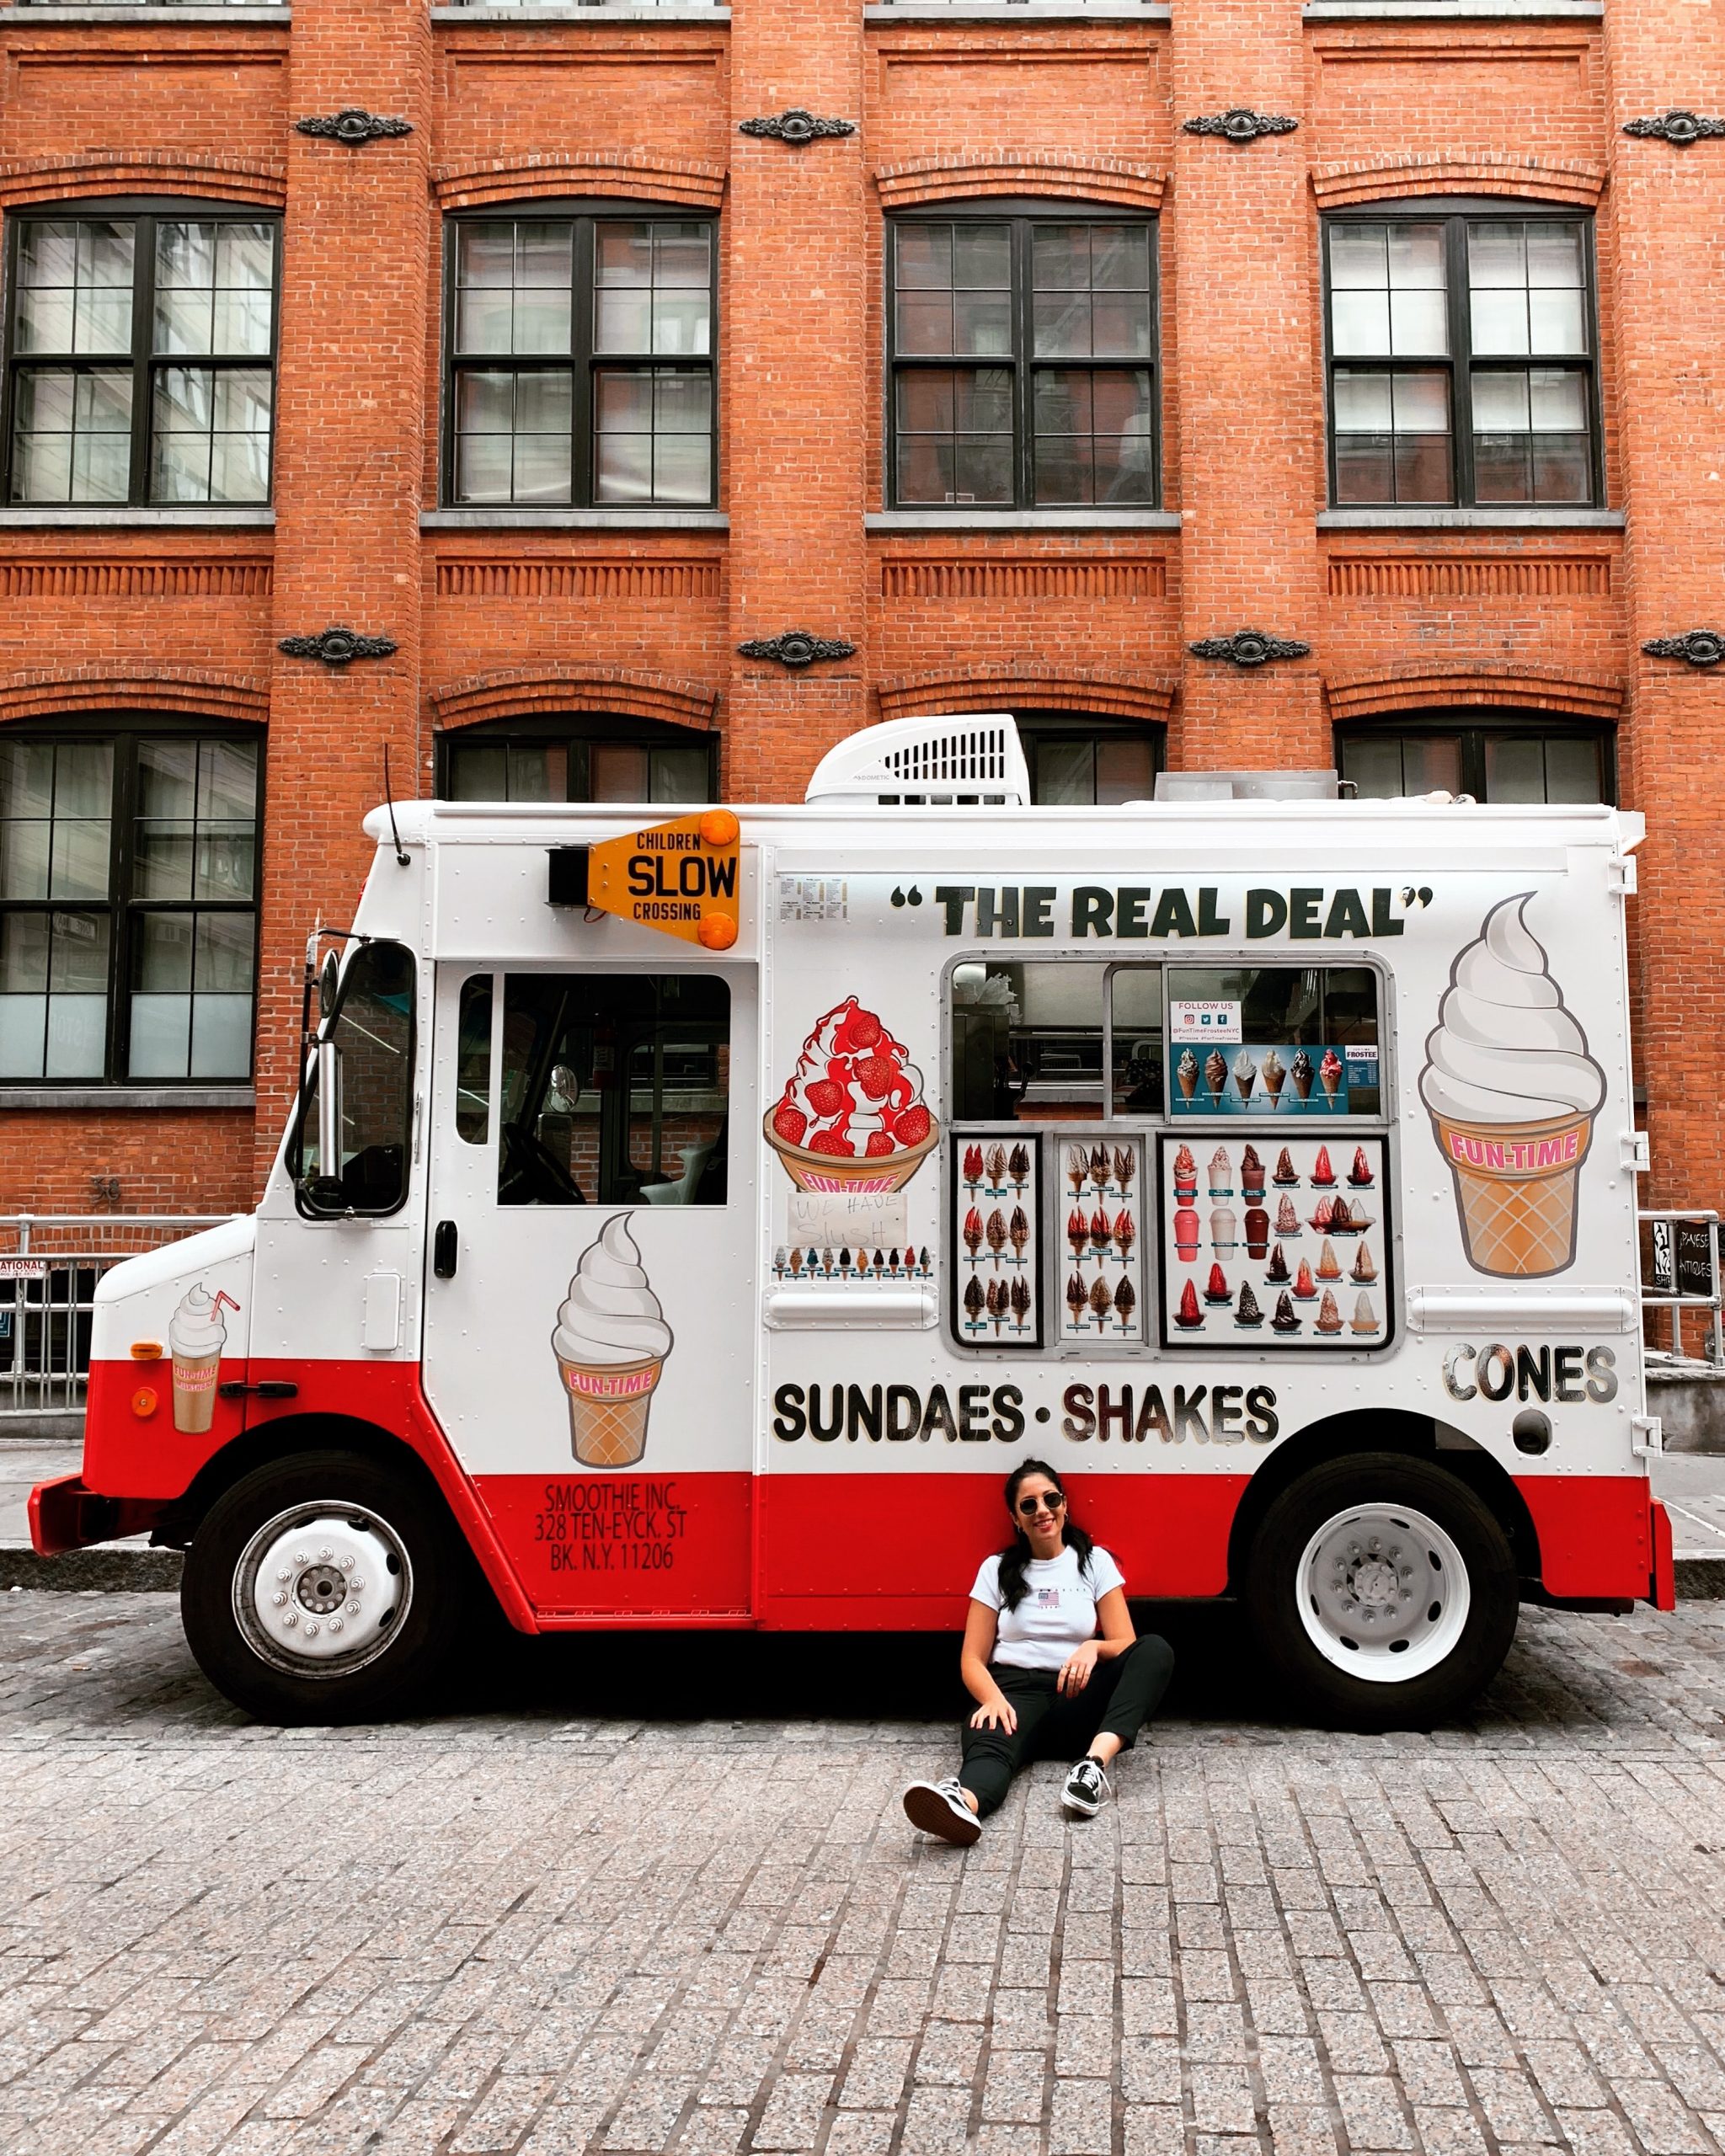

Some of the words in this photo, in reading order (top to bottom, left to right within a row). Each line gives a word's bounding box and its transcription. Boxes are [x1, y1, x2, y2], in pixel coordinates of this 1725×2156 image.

[637, 832, 701, 851] CHILDREN
[628, 855, 737, 899] SLOW
[633, 902, 701, 921] CROSSING
[1071, 886, 1230, 938] REAL
[1449, 1131, 1579, 1170] FUN-TIME
[796, 1168, 902, 1193] FUN-TIME
[797, 1198, 835, 1220] WE
[847, 1194, 898, 1214] HAVE
[569, 1369, 654, 1396] FUN-TIME
[1441, 1342, 1619, 1404] CONES
[772, 1383, 1026, 1443] SUNDAES
[1061, 1383, 1279, 1444] SHAKES
[545, 1483, 640, 1513] SMOOTHIE
[645, 1482, 681, 1510] INC.
[534, 1513, 567, 1541] 328
[666, 1510, 688, 1539] ST
[550, 1543, 578, 1572] BK.
[583, 1543, 615, 1570] N.Y.
[621, 1542, 674, 1570] 11206
